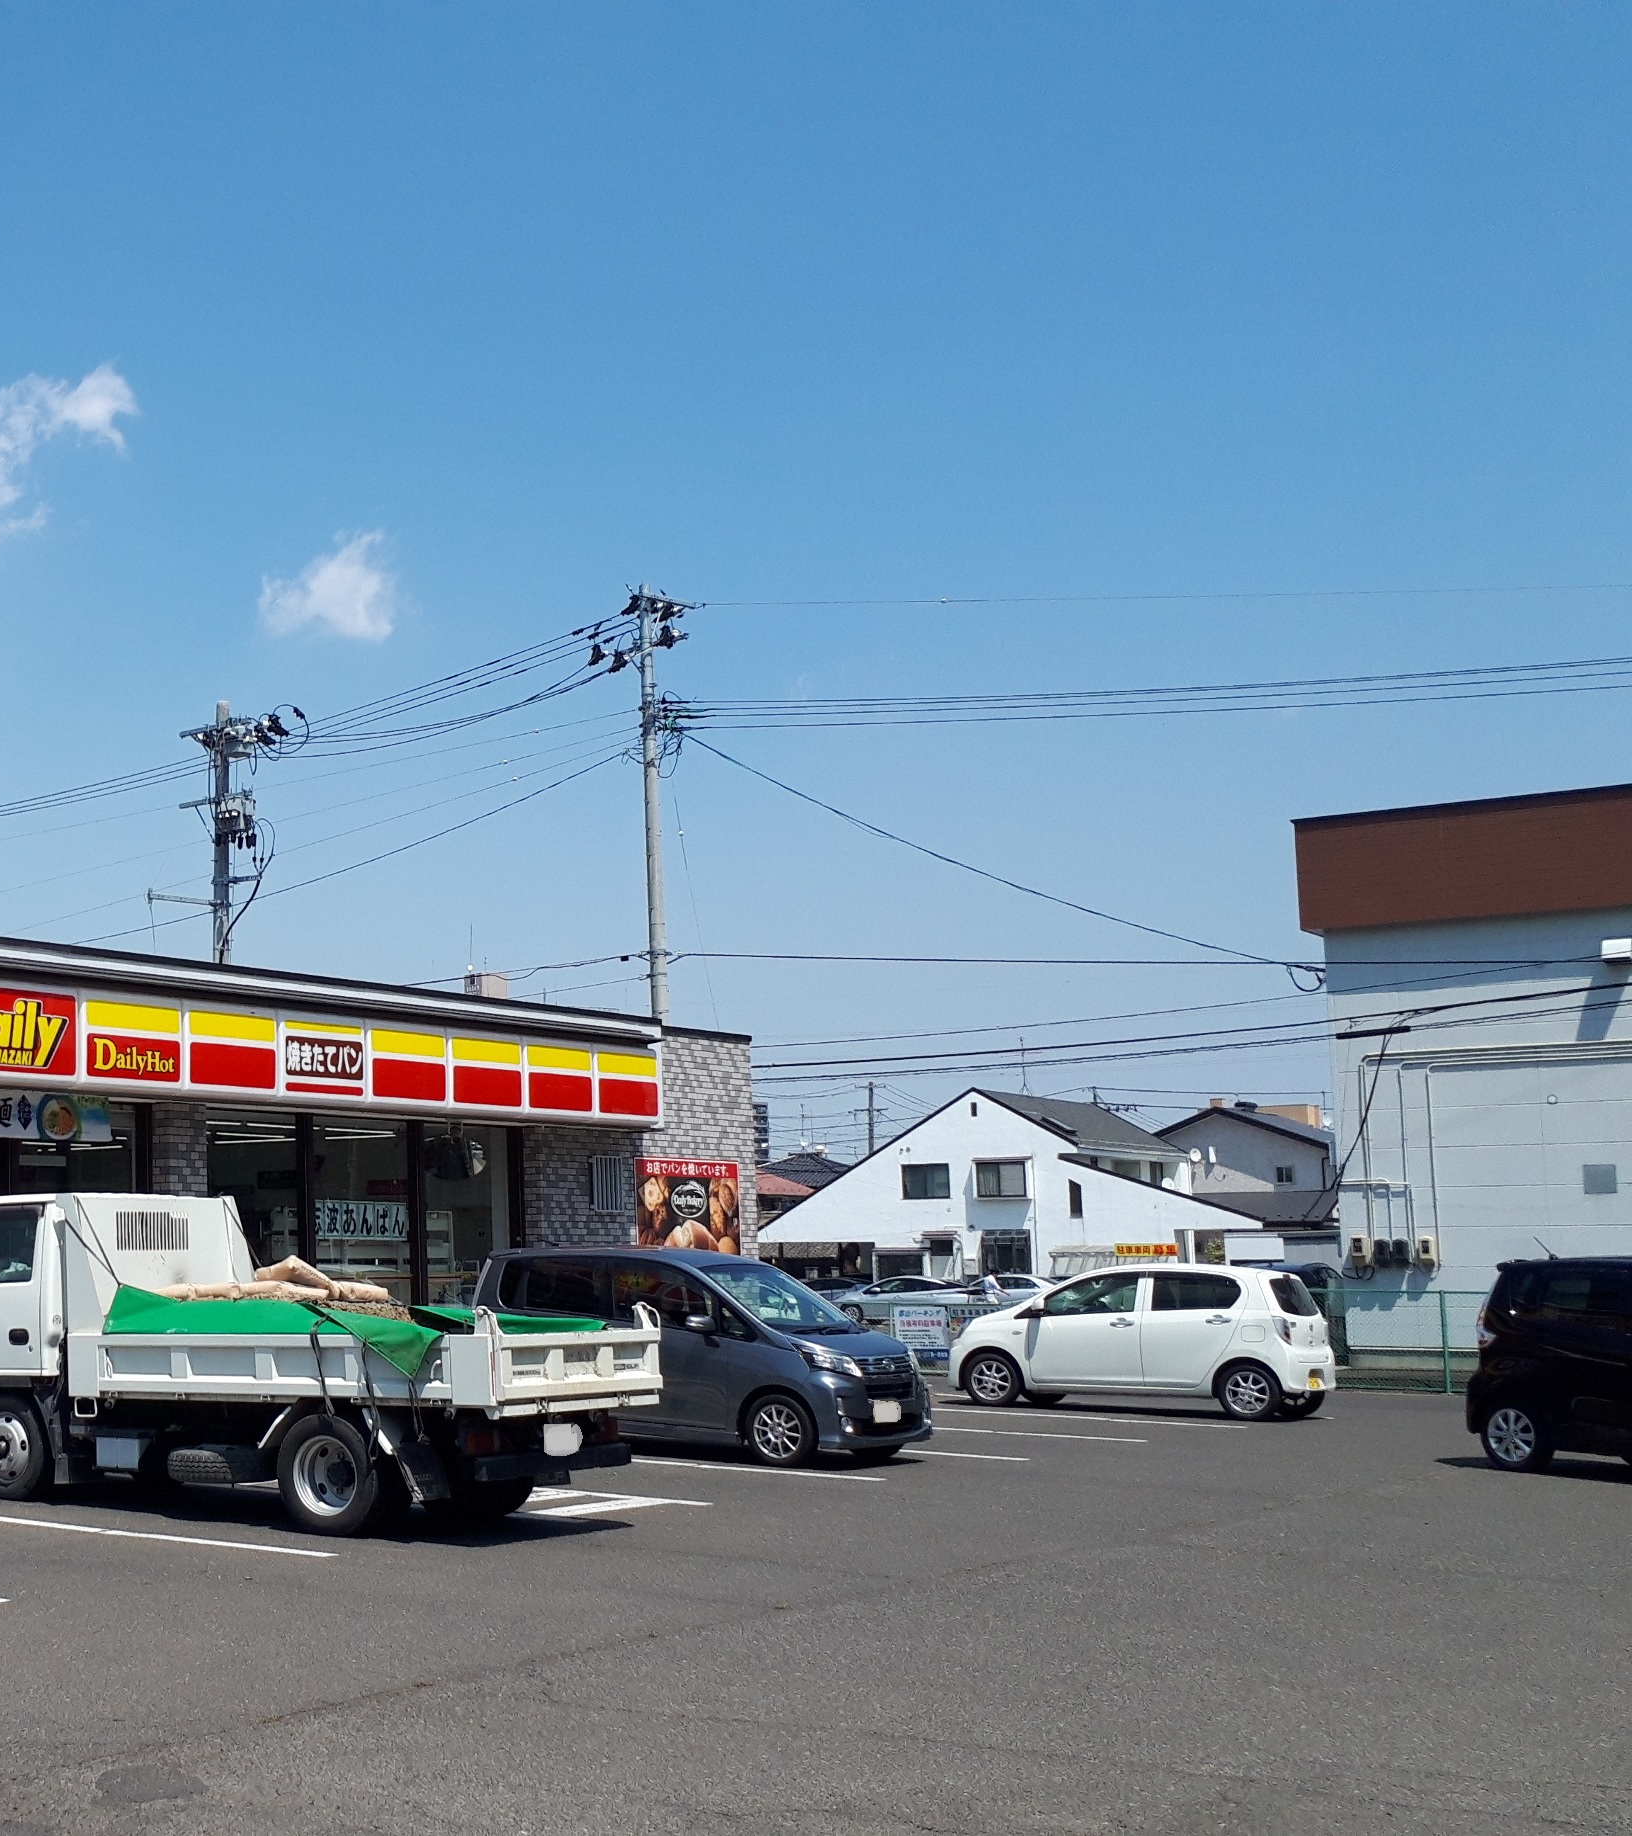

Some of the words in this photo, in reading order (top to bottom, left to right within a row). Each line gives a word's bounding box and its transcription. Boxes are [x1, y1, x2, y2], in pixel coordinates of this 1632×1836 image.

[286, 1040, 362, 1074] 焼きたてパン
[646, 1161, 729, 1177] お店でパンを焼いています。
